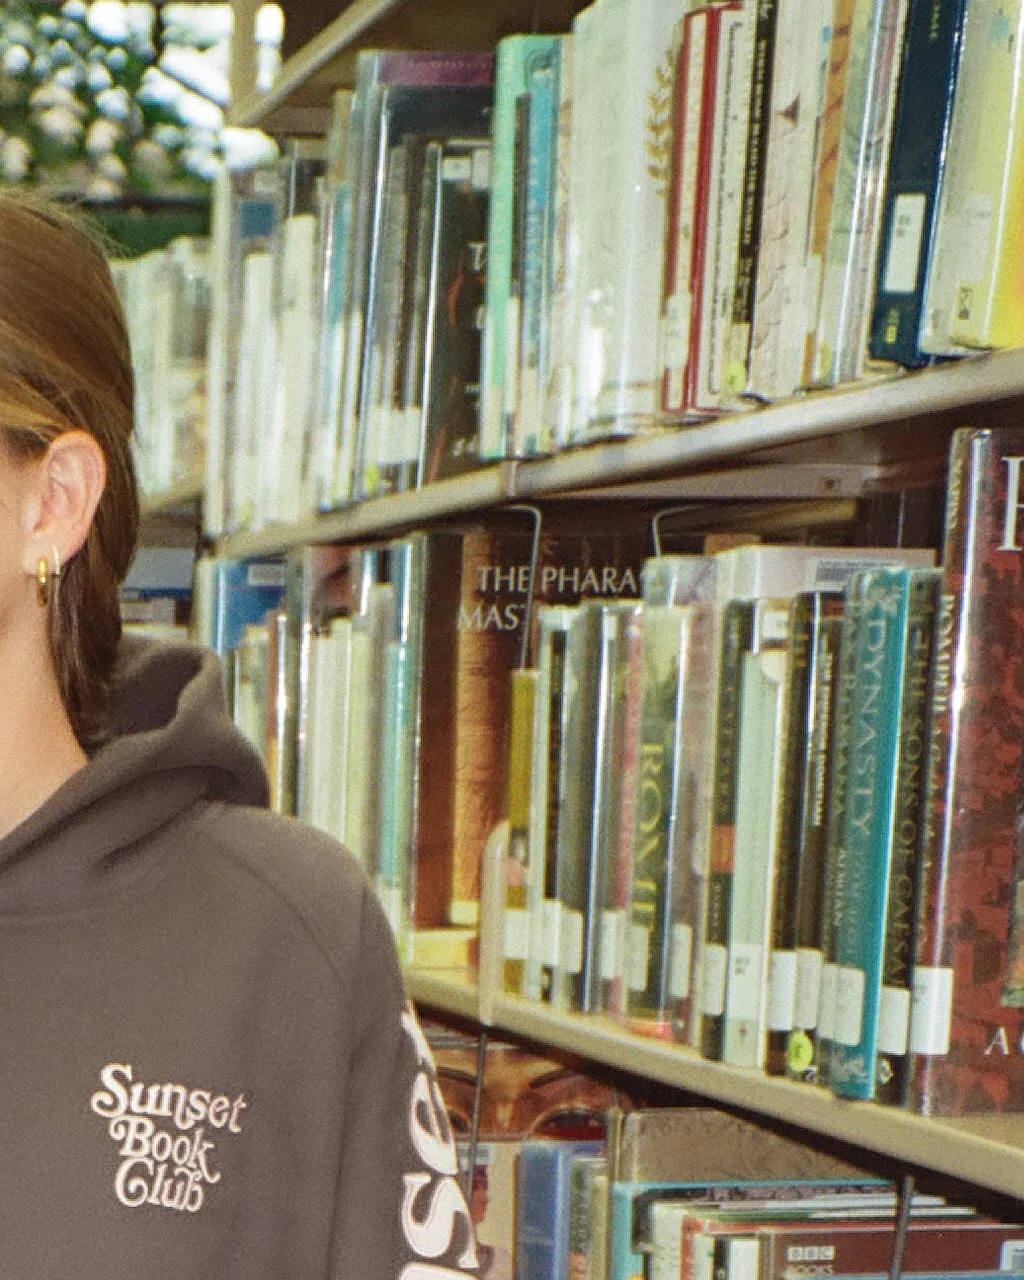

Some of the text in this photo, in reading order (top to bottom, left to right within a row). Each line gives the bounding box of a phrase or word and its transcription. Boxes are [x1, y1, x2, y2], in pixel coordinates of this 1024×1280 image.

[476, 565, 644, 594] THE PHARA
[850, 619, 888, 837] DYNASTY
[899, 716, 922, 809] SONS
[90, 1062, 248, 1133] Sunset
[109, 1114, 222, 1184] Book
[115, 1157, 204, 1212] Club
[790, 1246, 835, 1262] BBC
